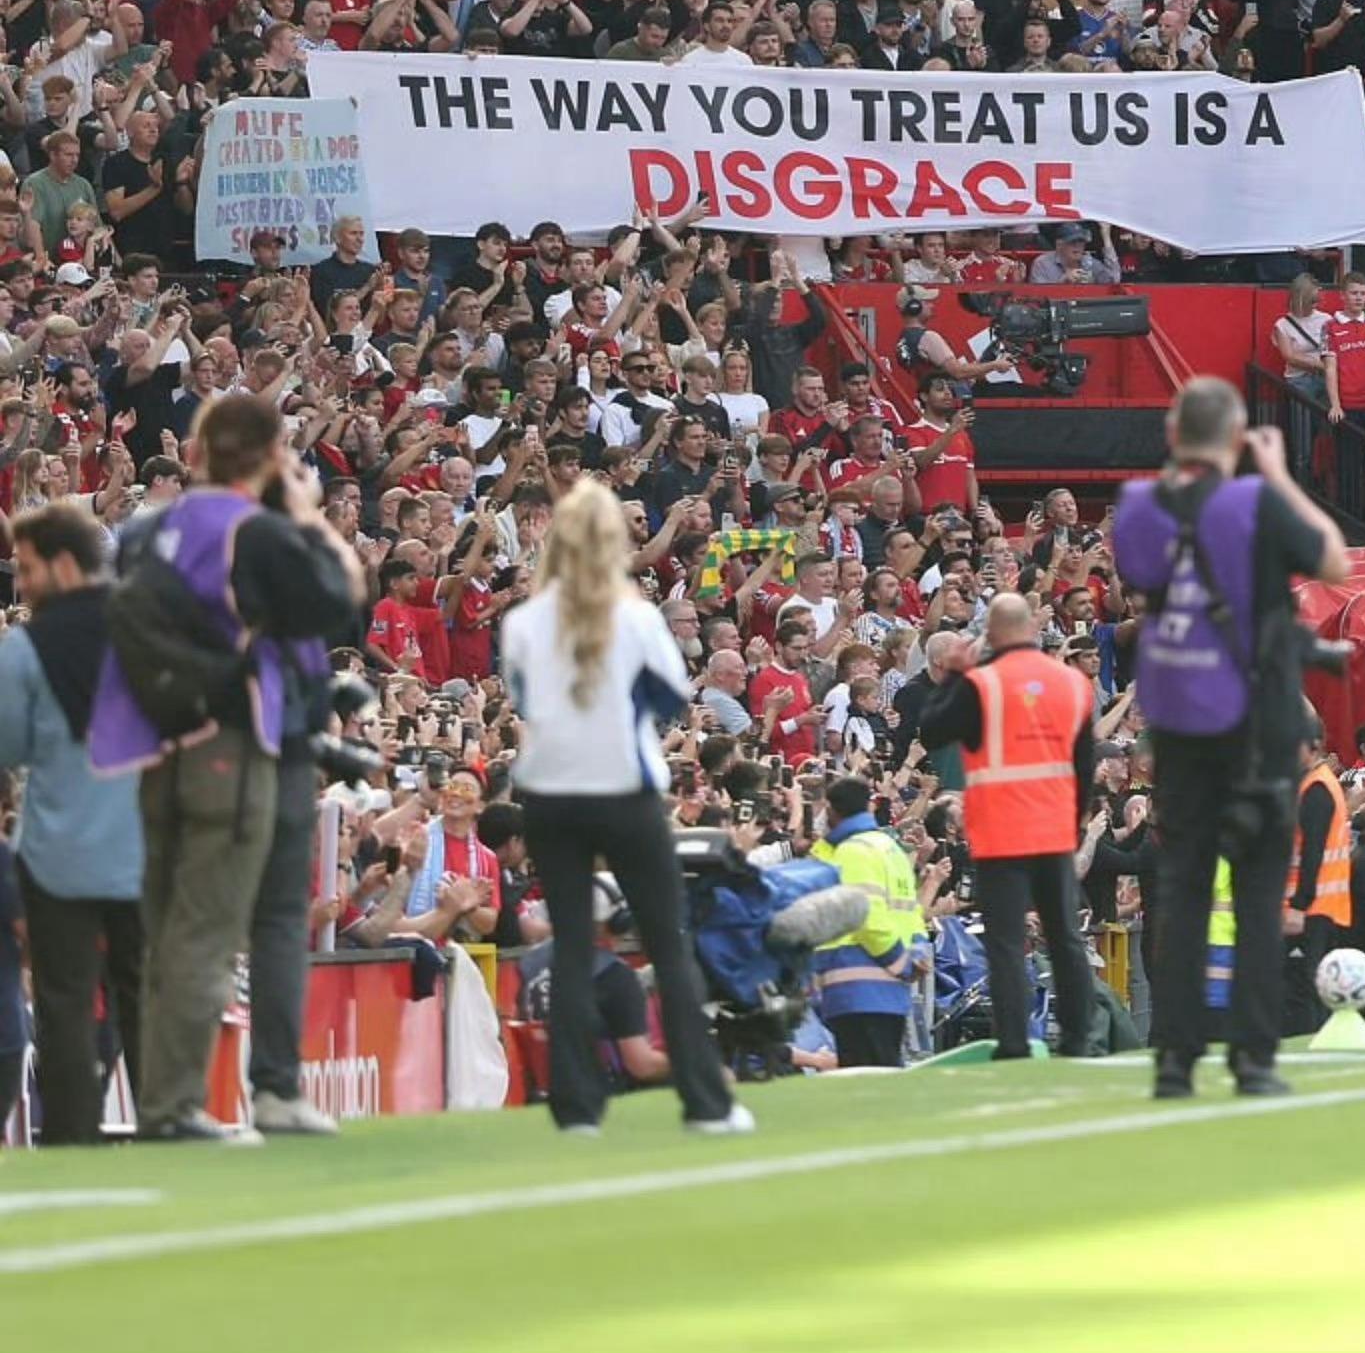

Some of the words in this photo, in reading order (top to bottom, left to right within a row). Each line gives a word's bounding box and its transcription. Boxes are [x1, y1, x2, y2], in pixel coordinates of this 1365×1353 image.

[399, 75, 514, 130] THE
[529, 78, 670, 133] WAY
[688, 84, 829, 142] YOU
[850, 89, 1045, 144] TREAT
[1068, 92, 1150, 146] US
[1174, 92, 1227, 146] IS
[1244, 92, 1285, 146] A
[629, 148, 1081, 221] DISGRACE
